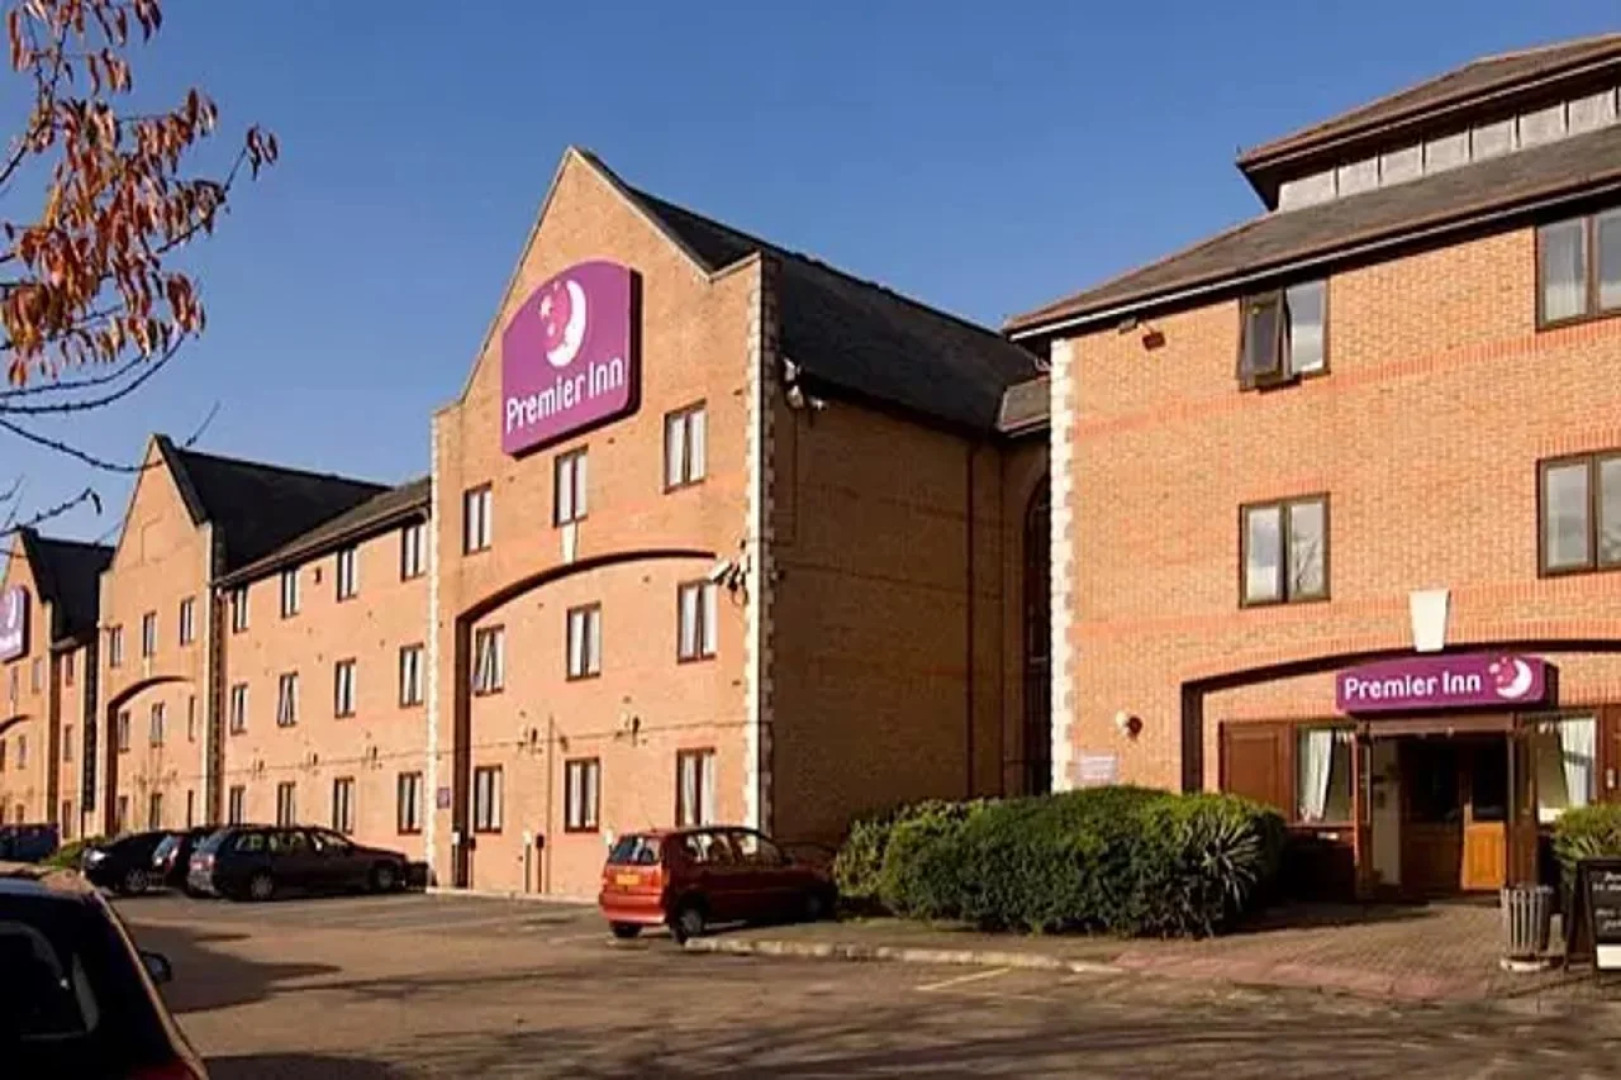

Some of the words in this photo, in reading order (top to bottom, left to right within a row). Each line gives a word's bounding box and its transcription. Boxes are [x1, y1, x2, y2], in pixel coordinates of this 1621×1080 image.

[506, 374, 585, 434] Premier
[589, 357, 623, 398] Inn
[1344, 674, 1438, 700] Premier
[1443, 671, 1481, 694] Inn
